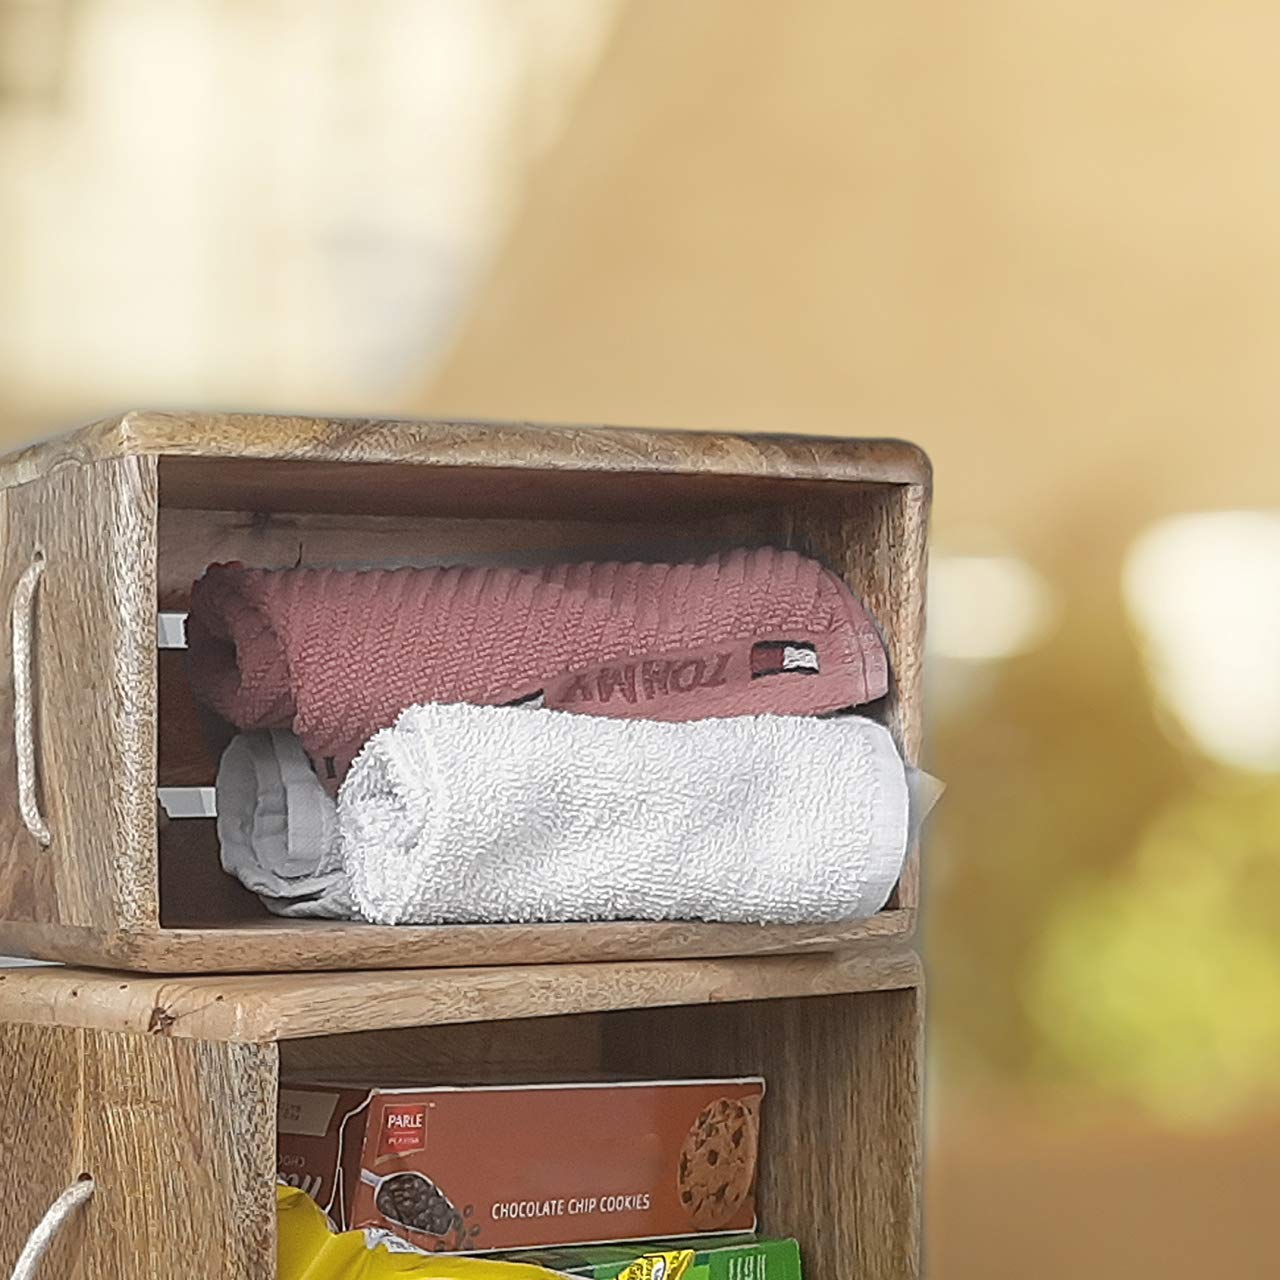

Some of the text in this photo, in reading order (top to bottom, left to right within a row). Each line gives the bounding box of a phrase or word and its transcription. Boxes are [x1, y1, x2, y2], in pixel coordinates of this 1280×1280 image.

[560, 652, 732, 703] TOMMY
[387, 1113, 423, 1128] PARLE
[491, 1193, 651, 1220] CHOCOLATE CHIP COOKIES
